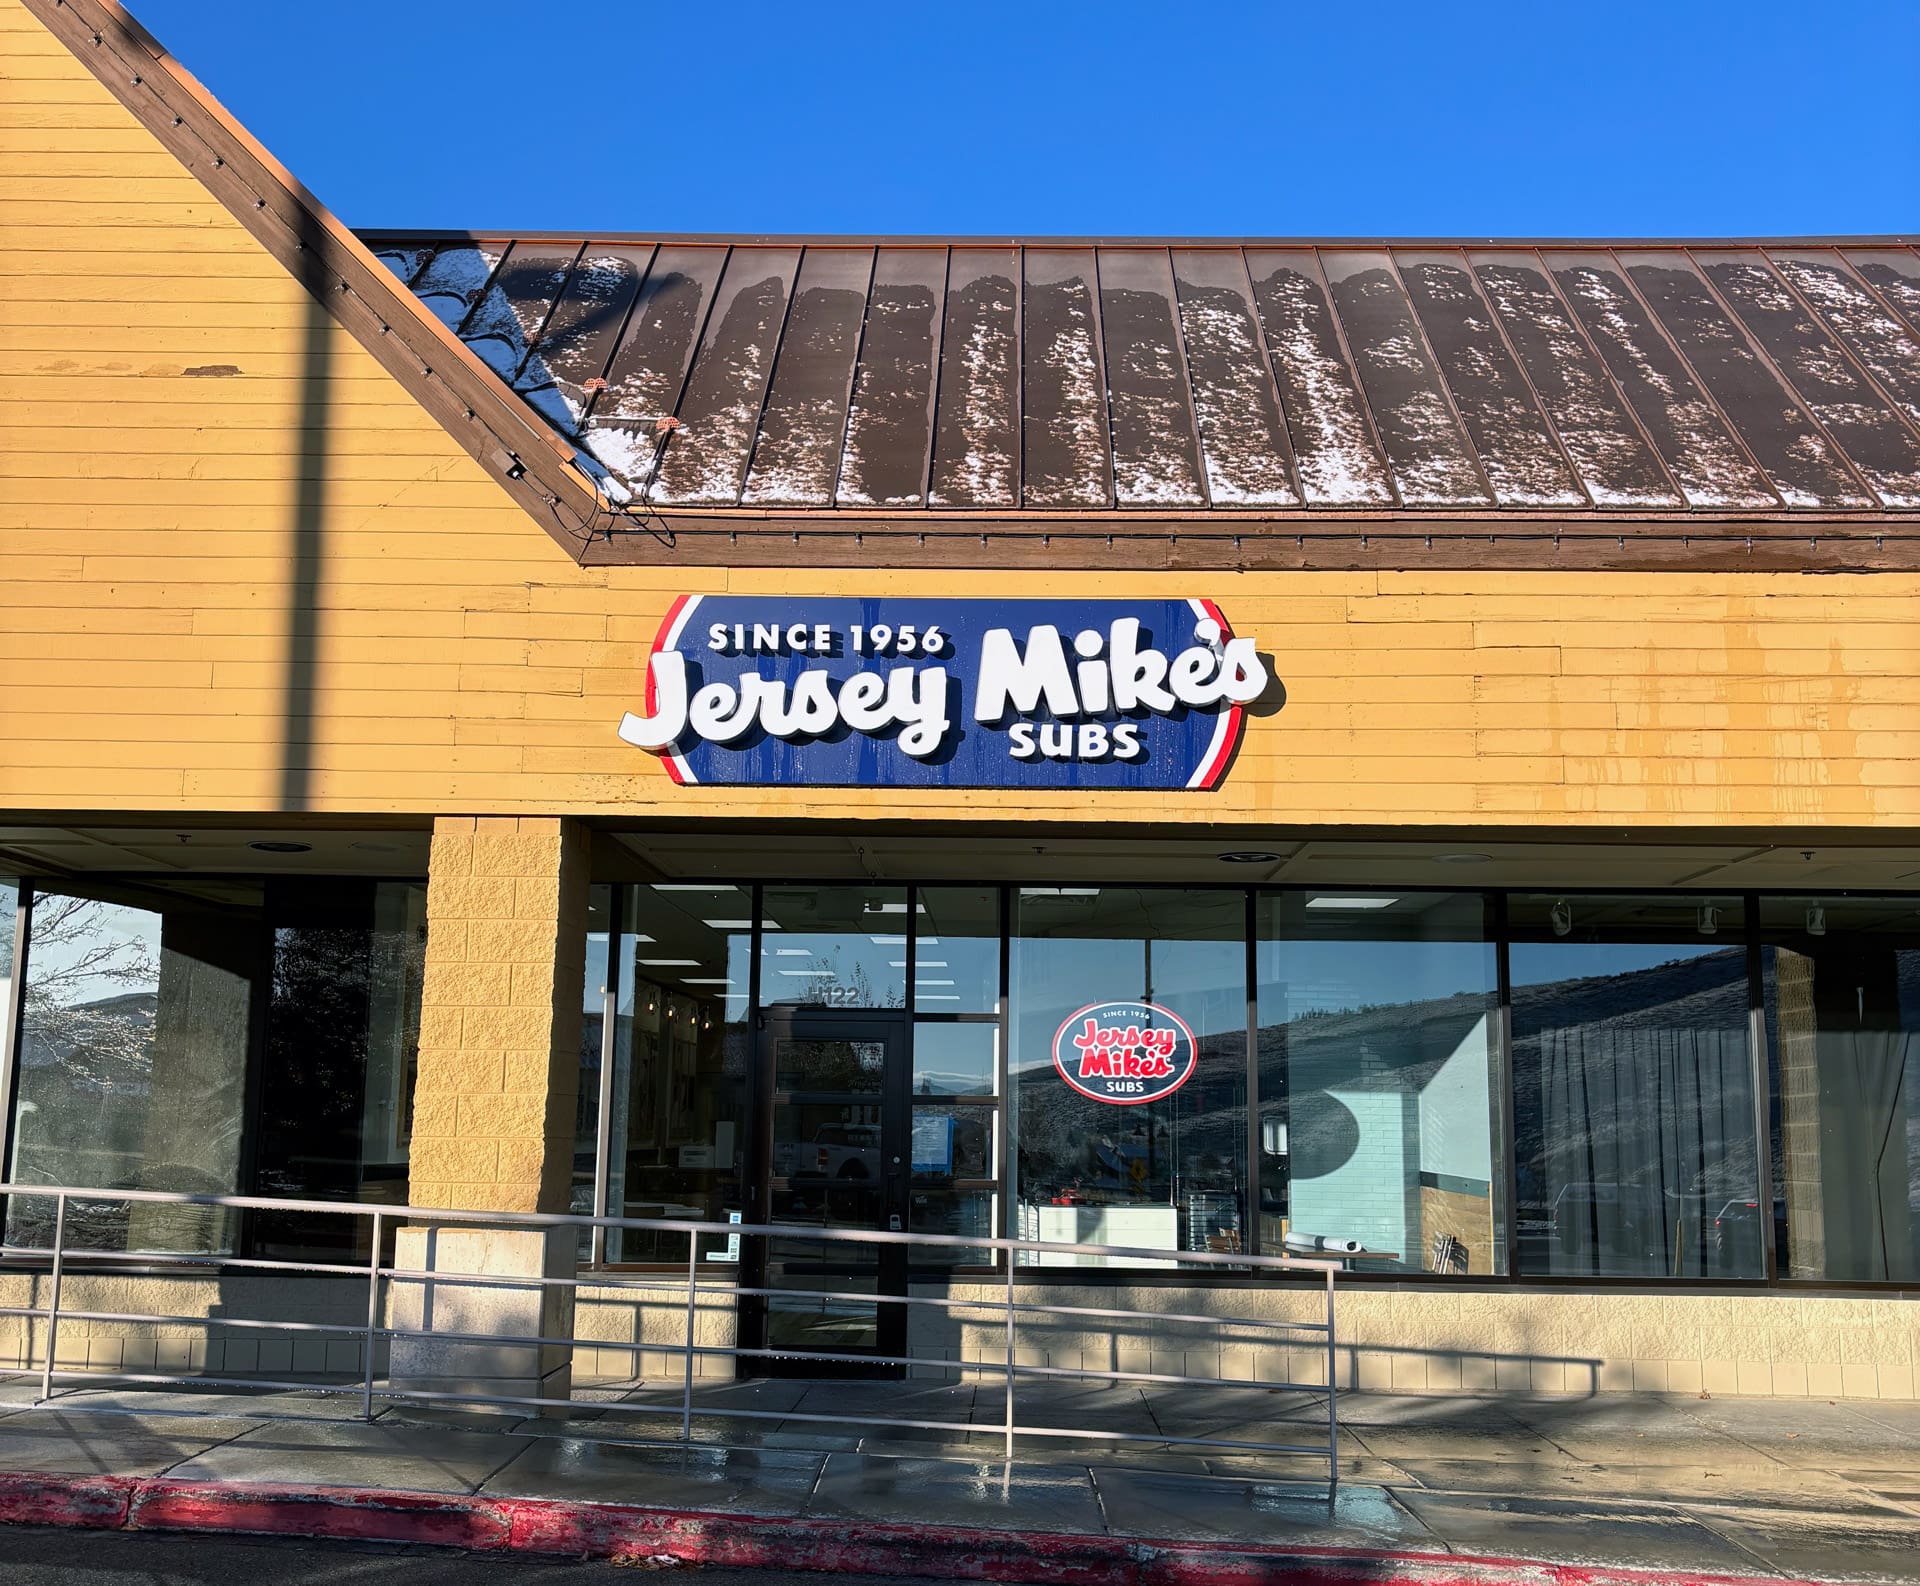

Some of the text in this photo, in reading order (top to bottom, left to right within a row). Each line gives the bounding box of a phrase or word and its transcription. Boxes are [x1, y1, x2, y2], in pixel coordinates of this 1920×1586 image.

[708, 623, 945, 652] SINCE 1956
[617, 617, 1268, 758] Jersey Mike's
[1008, 722, 1143, 759] SUBS
[1102, 1010, 1151, 1020] SINCE 1956
[1073, 1018, 1176, 1056] Jersey
[1079, 1047, 1175, 1079] Mike's
[1106, 1081, 1144, 1093] SUBS
